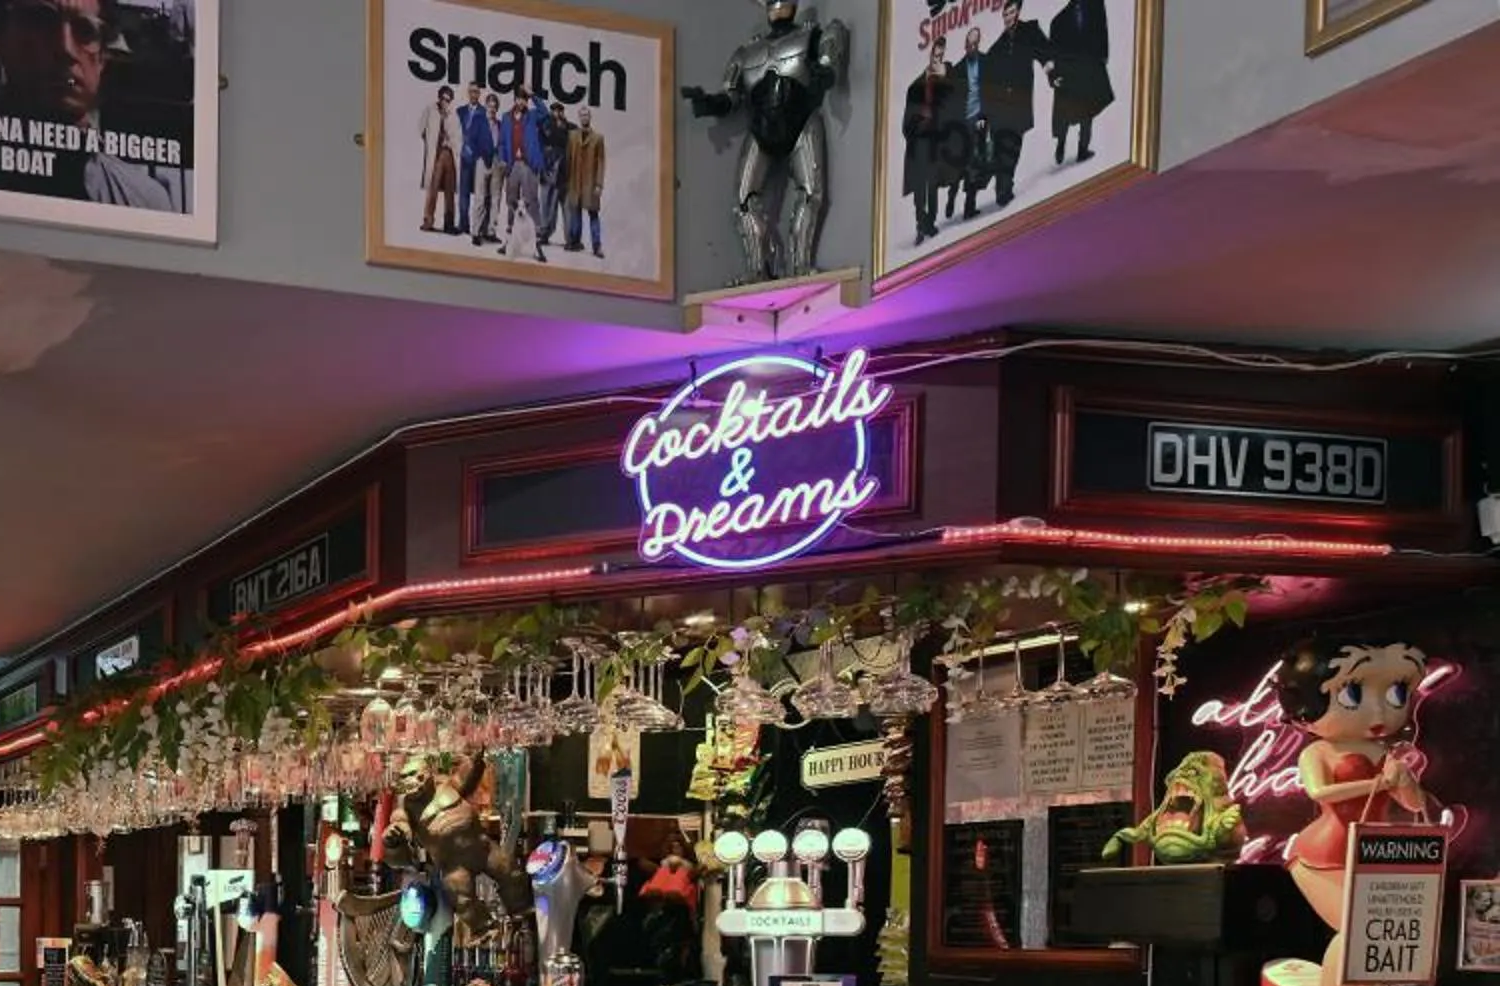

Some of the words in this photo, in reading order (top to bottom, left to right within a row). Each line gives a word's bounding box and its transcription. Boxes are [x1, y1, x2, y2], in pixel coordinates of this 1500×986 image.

[407, 27, 627, 111] snatch
[1, 147, 56, 177] BOAT
[29, 120, 79, 152] NEED
[85, 127, 100, 153] A
[104, 131, 181, 165] BIGGER
[624, 348, 893, 475] Cocktails
[719, 447, 755, 497] &
[1153, 431, 1249, 487] DHV
[642, 470, 878, 556] Dreams
[808, 755, 846, 777] HAPPY
[848, 750, 886, 770] HOUR
[1362, 841, 1440, 860] WARNING
[1365, 918, 1422, 942] CRAB
[1364, 945, 1420, 973] BAIT
